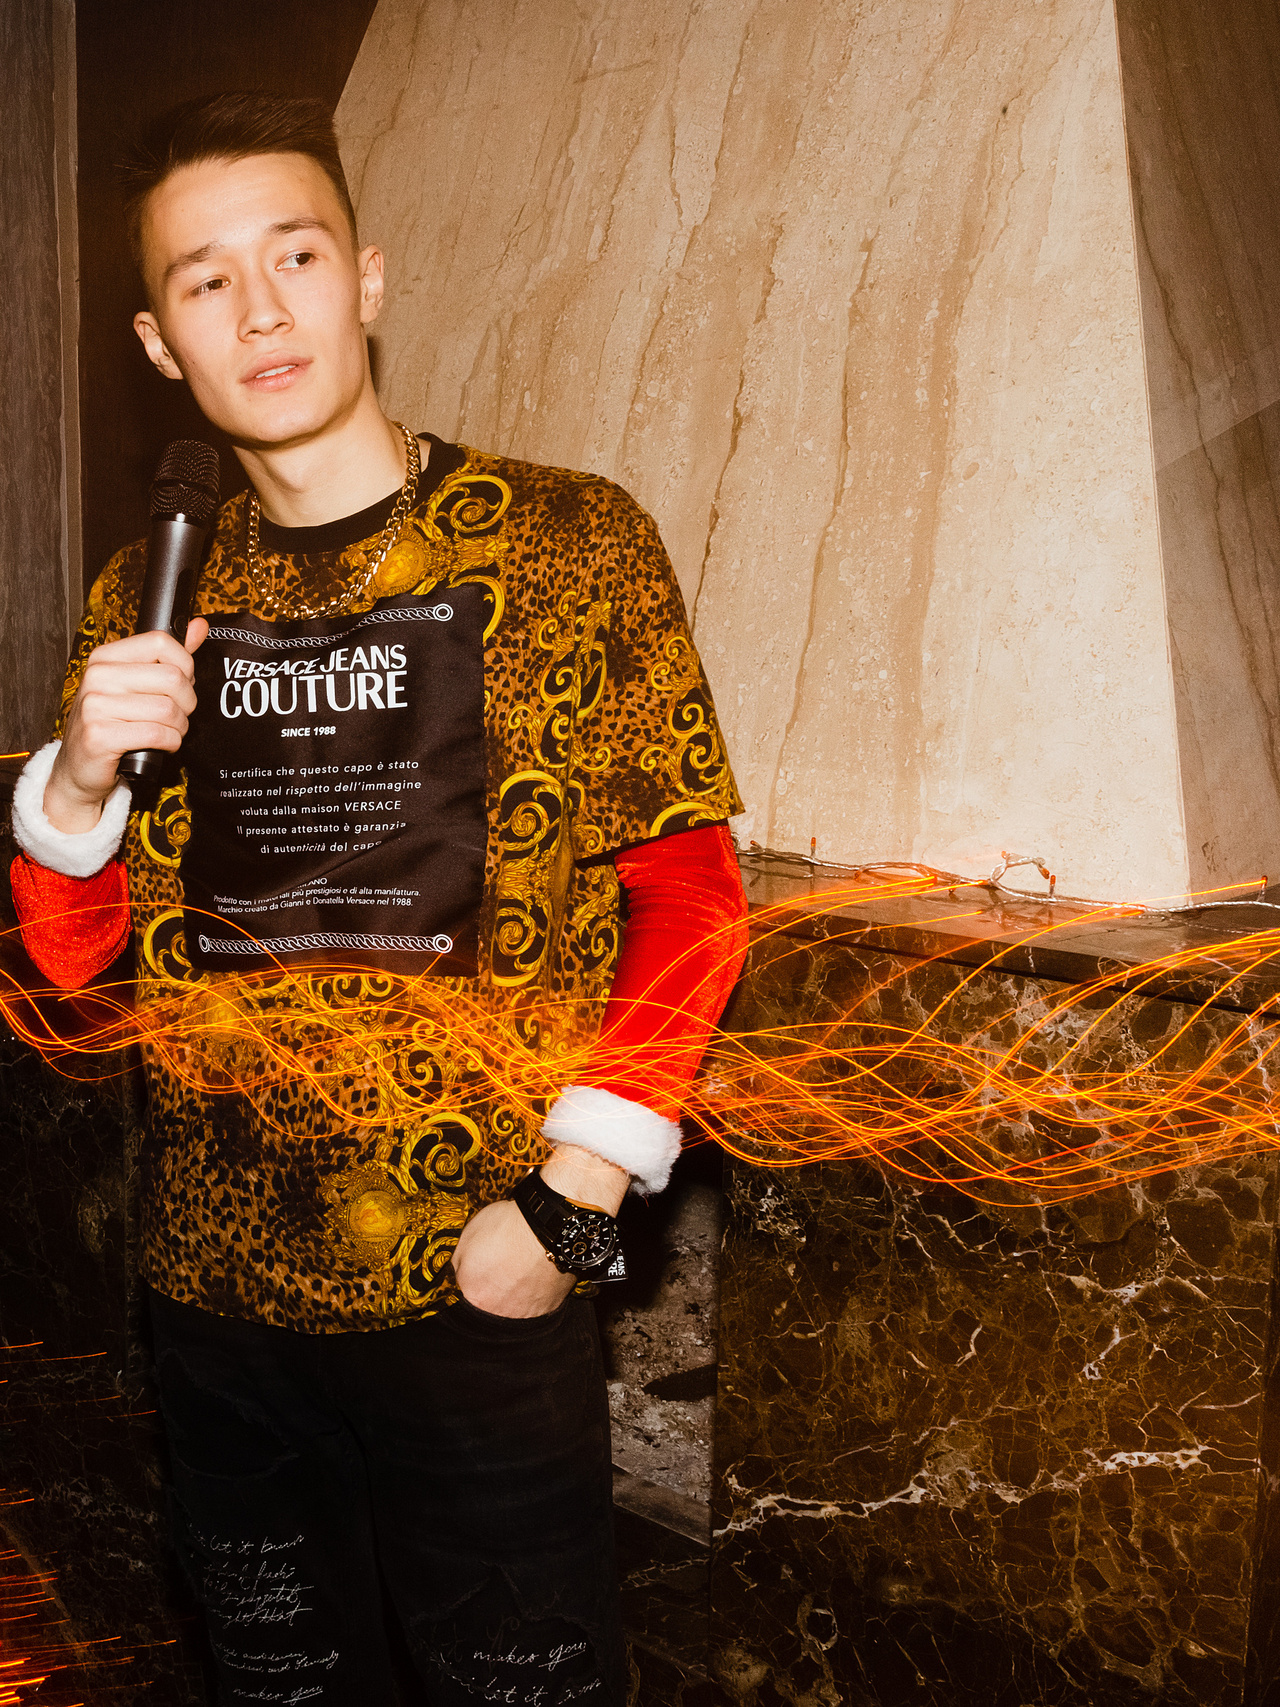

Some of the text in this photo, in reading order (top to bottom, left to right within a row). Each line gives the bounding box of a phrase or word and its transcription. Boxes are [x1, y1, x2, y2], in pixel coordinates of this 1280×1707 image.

[223, 644, 407, 679] VERSACE JEANS
[220, 670, 408, 719] COUTURE
[281, 725, 336, 738] SINCE 1988
[219, 760, 419, 779] Si certifica che questo capo è stato
[220, 787, 263, 798] realizzato
[266, 786, 282, 797] nel
[285, 784, 330, 798] rispetto
[240, 800, 402, 816] voluta dalla maison VERSACE
[245, 826, 287, 838] presente
[291, 823, 340, 834] attestato
[343, 821, 350, 832] è
[354, 820, 407, 835] garanzia
[260, 844, 270, 854] di
[274, 843, 326, 854] autenticità
[330, 841, 348, 852] del
[217, 904, 243, 914] Marchio
[244, 904, 268, 914] creato
[269, 902, 279, 912] da
[280, 899, 304, 909] Gianni
[313, 896, 345, 906] Donatella
[346, 896, 375, 906] Versace
[376, 897, 389, 906] nel
[391, 897, 413, 908] 1988.
[238, 898, 251, 907] con
[291, 889, 305, 900] più
[305, 886, 341, 899] prestigiosi
[349, 887, 357, 895] di
[358, 886, 373, 896] alta
[374, 887, 421, 897] manifattura.
